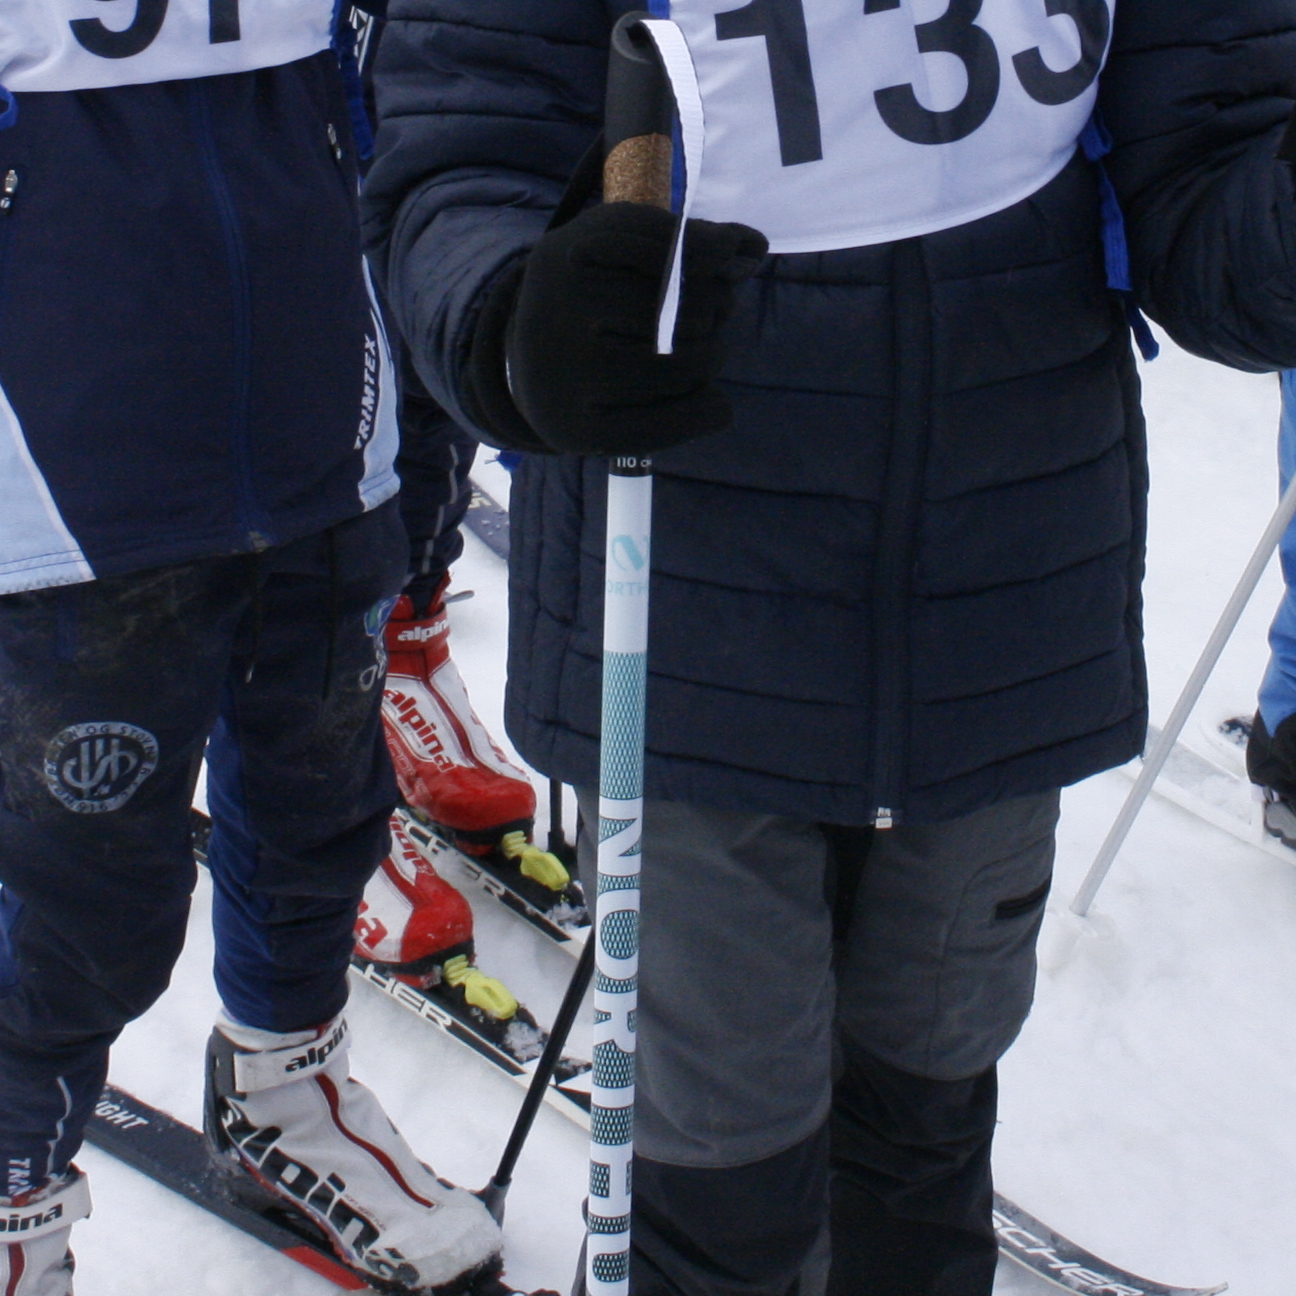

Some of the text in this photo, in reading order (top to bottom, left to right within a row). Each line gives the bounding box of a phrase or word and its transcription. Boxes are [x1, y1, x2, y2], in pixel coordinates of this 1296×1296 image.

[354, 333, 376, 450] TRIMTEX
[616, 456, 637, 468] 110
[397, 618, 450, 643] alpin
[284, 1015, 348, 1074] alpin
